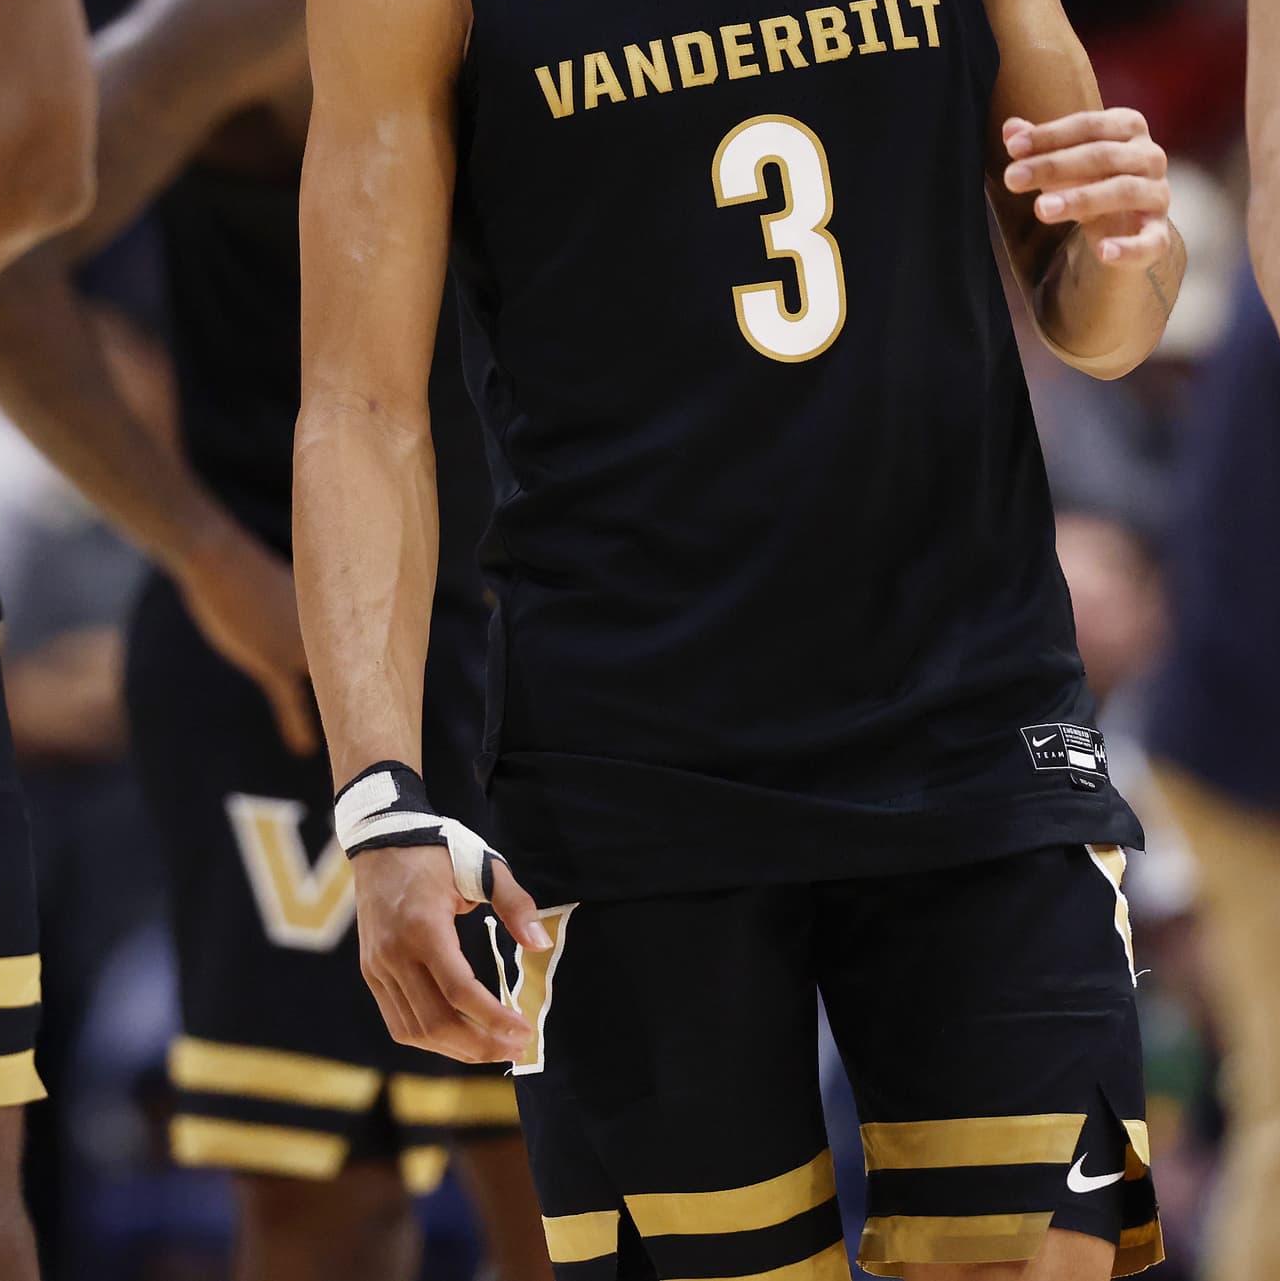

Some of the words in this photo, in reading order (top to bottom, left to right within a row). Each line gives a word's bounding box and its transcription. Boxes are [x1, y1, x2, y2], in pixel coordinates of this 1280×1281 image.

[711, 113, 848, 364] 3
[1035, 751, 1065, 759] TEAM
[224, 792, 357, 953] V
